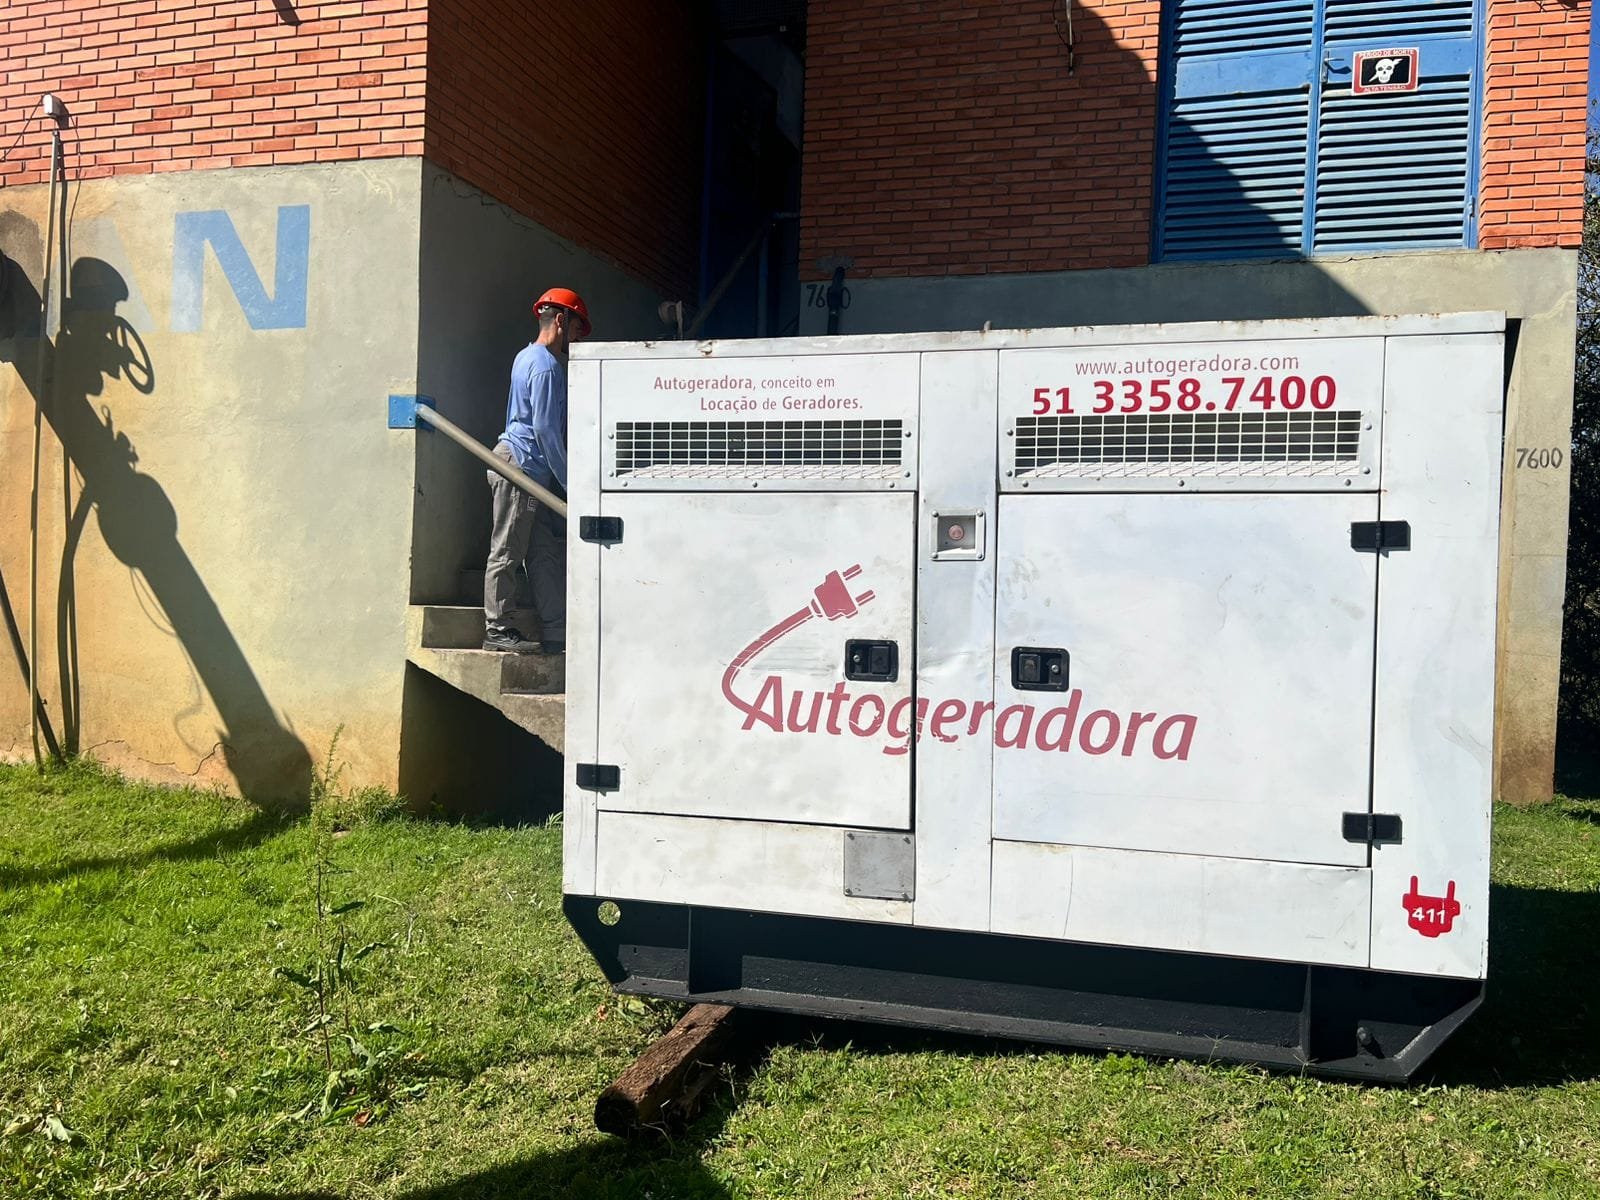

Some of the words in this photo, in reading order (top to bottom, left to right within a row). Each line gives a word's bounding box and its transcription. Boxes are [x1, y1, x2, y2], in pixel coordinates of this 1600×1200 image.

[806, 284, 851, 309] 760
[1075, 353, 1299, 377] www.autogeradora.com
[653, 375, 756, 393] Autogeradora,
[761, 376, 812, 389] conceito
[816, 377, 835, 388] em
[1032, 387, 1074, 415] 51
[1092, 375, 1337, 412] 3358.7400
[700, 396, 757, 414] Locação
[762, 398, 777, 410] de
[782, 395, 863, 410] Geradores.
[1516, 447, 1563, 469] 7600
[741, 675, 1198, 761] Autogeradora
[1412, 907, 1446, 924] 411
